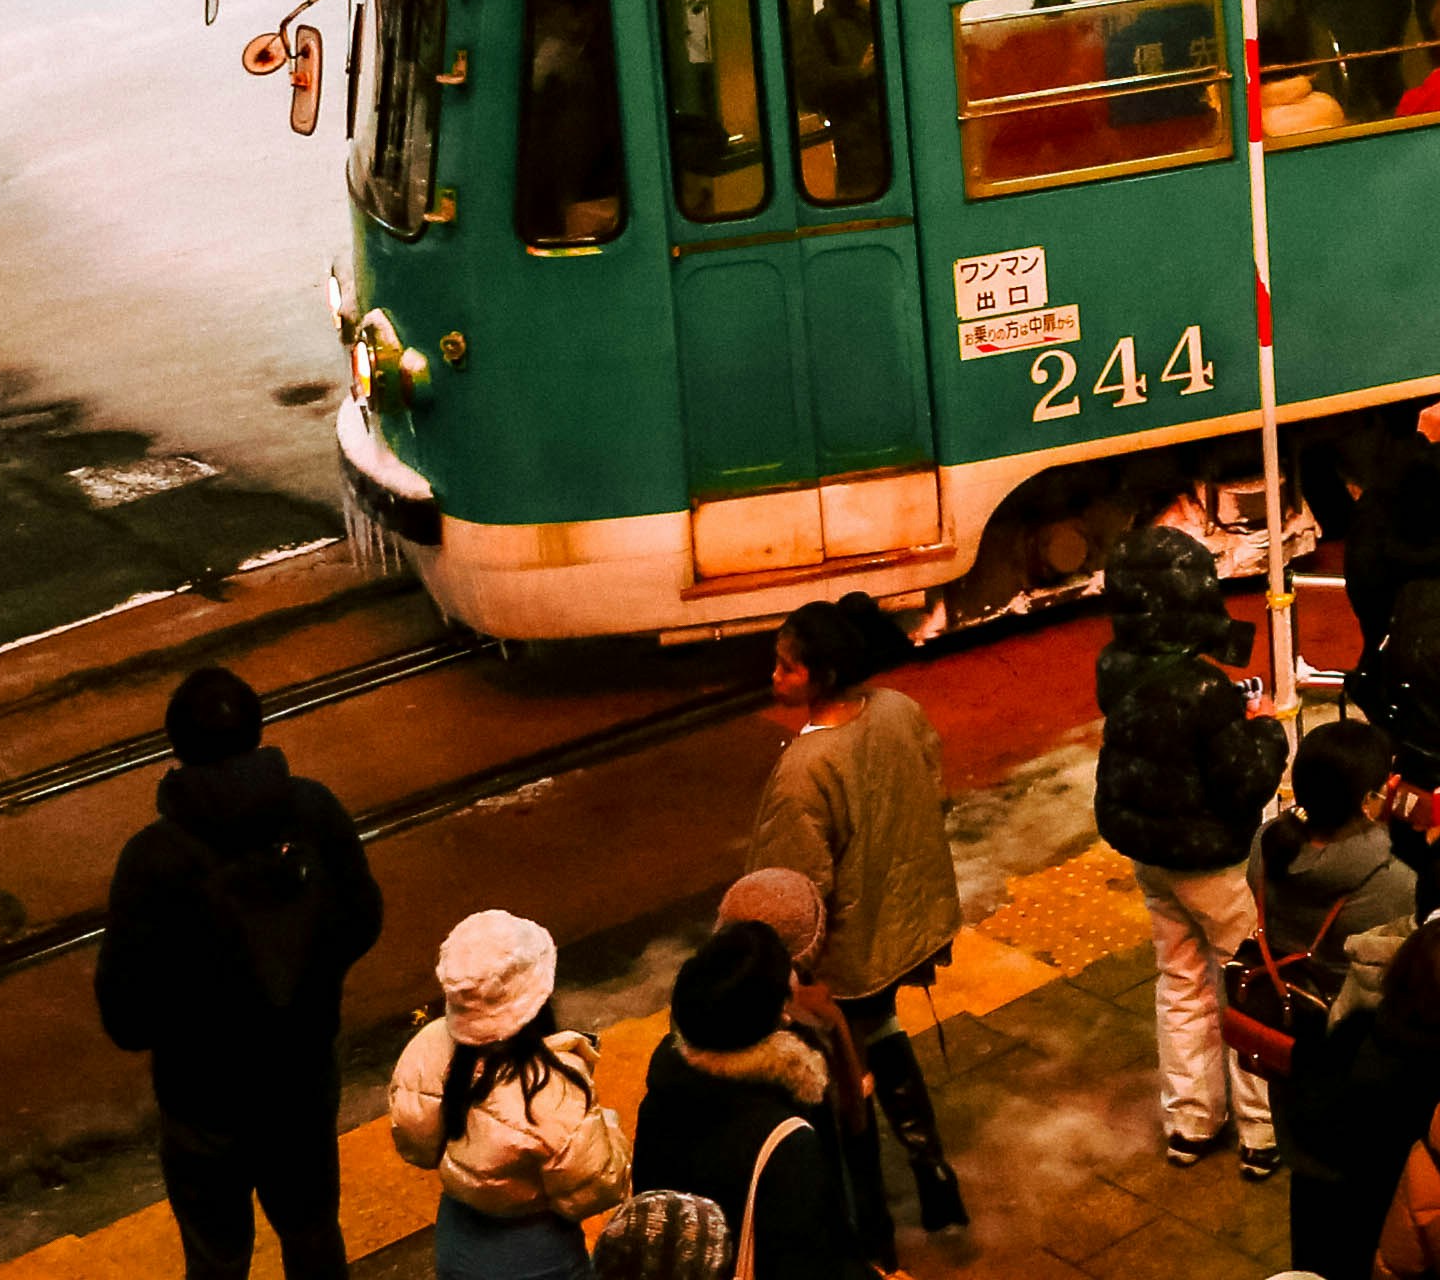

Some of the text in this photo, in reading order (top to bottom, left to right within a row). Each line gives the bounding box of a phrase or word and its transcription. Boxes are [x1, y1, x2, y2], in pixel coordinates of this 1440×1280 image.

[960, 254, 1039, 284] ワンマン
[976, 284, 1029, 311] 出口
[963, 312, 1076, 347] お乗りの方は中扉から
[1031, 324, 1215, 425] 244
